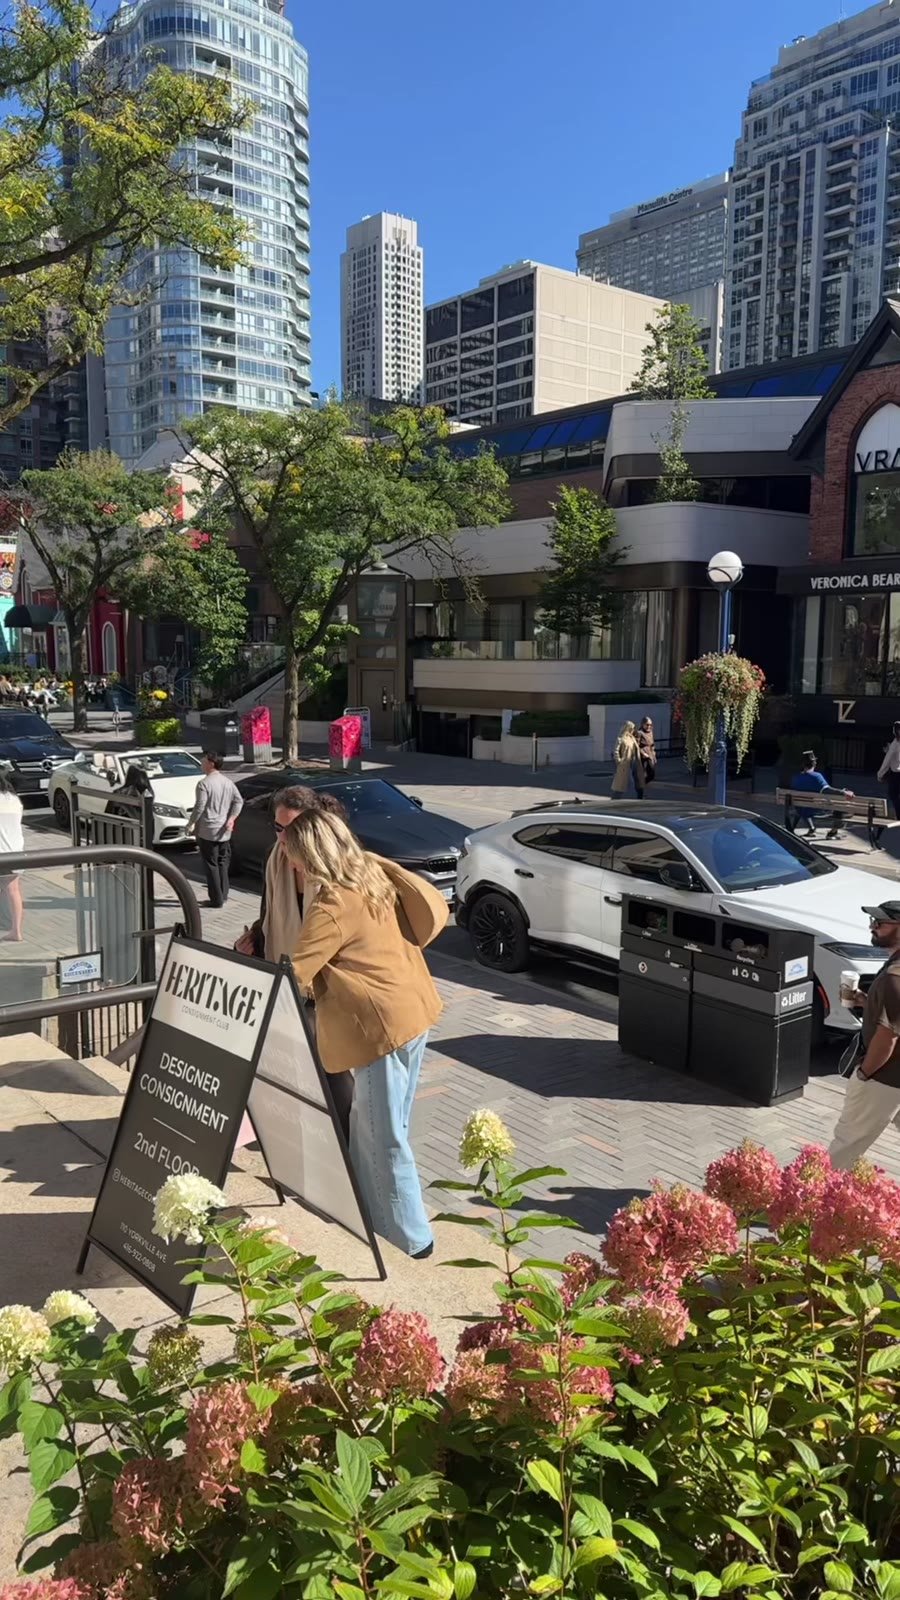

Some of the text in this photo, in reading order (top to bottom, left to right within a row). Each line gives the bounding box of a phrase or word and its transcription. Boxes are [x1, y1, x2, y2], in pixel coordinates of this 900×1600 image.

[637, 188, 693, 213] Manulife Centre
[811, 575, 868, 589] VERONICA
[165, 961, 263, 1027] HERITAGE
[788, 991, 807, 1006] Litter
[181, 1005, 230, 1031] CONSIGNMENT CLUB
[159, 1052, 220, 1097] DESIGNER
[140, 1073, 229, 1133] CONSIGNMENT
[134, 1132, 158, 1159] 2nd
[120, 1175, 154, 1203] HERITAGECO
[128, 1226, 156, 1254] YORKVILLE
[156, 1250, 167, 1264] AVE
